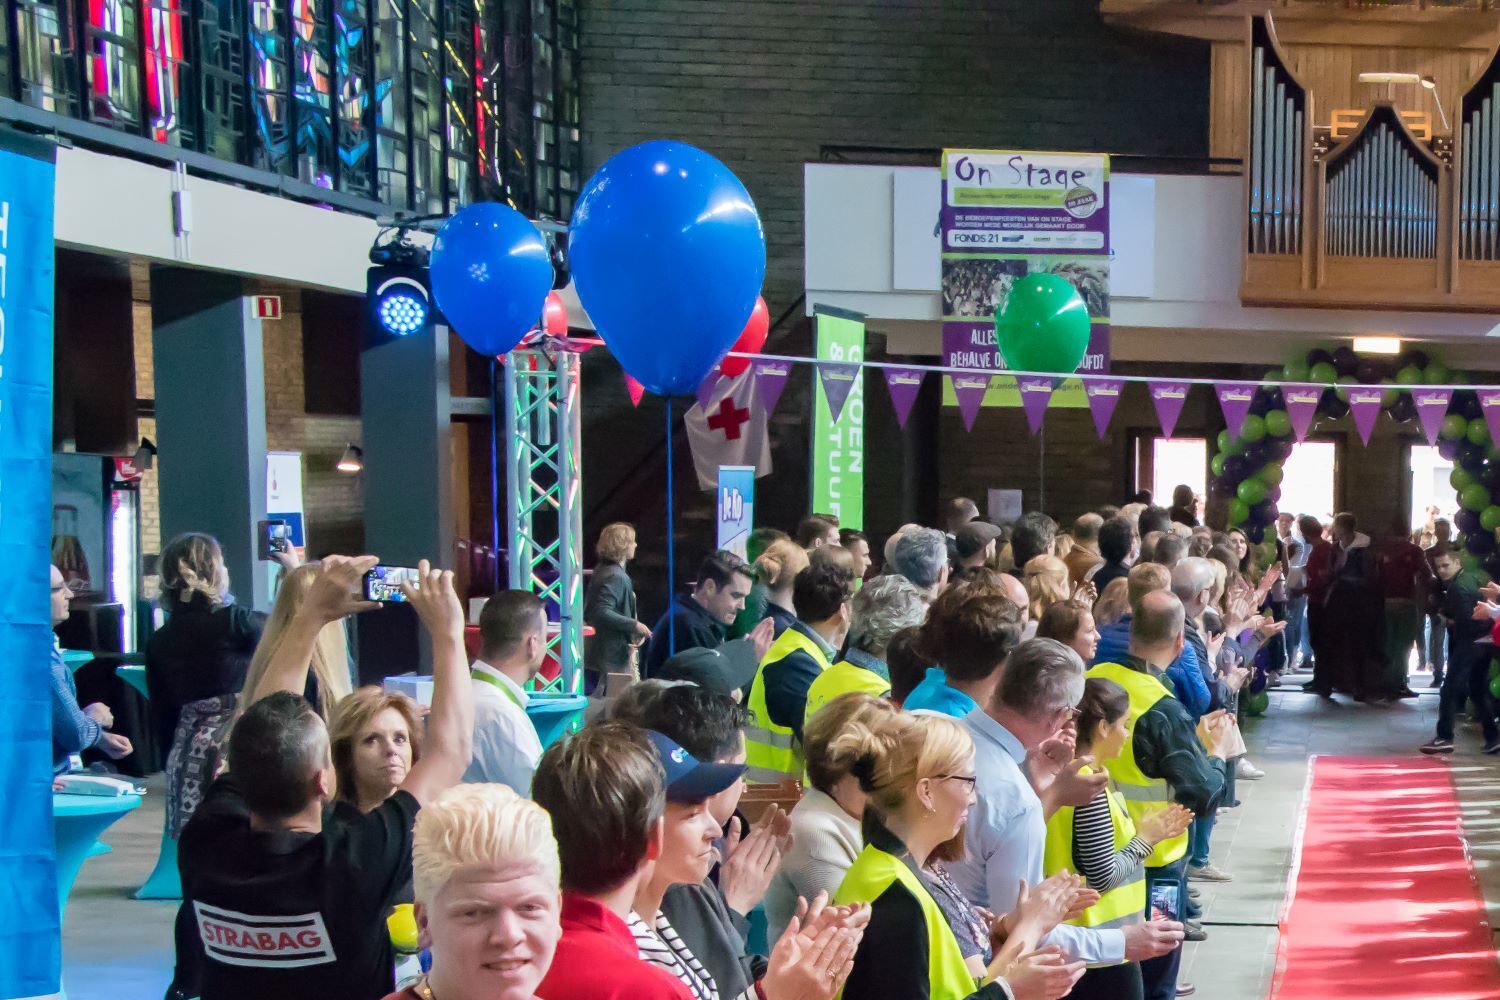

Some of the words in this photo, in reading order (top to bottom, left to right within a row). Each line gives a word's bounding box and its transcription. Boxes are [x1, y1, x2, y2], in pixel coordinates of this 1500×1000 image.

[955, 156, 992, 186] On
[1008, 155, 1087, 189] Stage
[954, 233, 986, 243] FONDS
[988, 233, 999, 243] 21
[950, 351, 991, 368] BEHALVE
[202, 920, 322, 951] STRABAG
